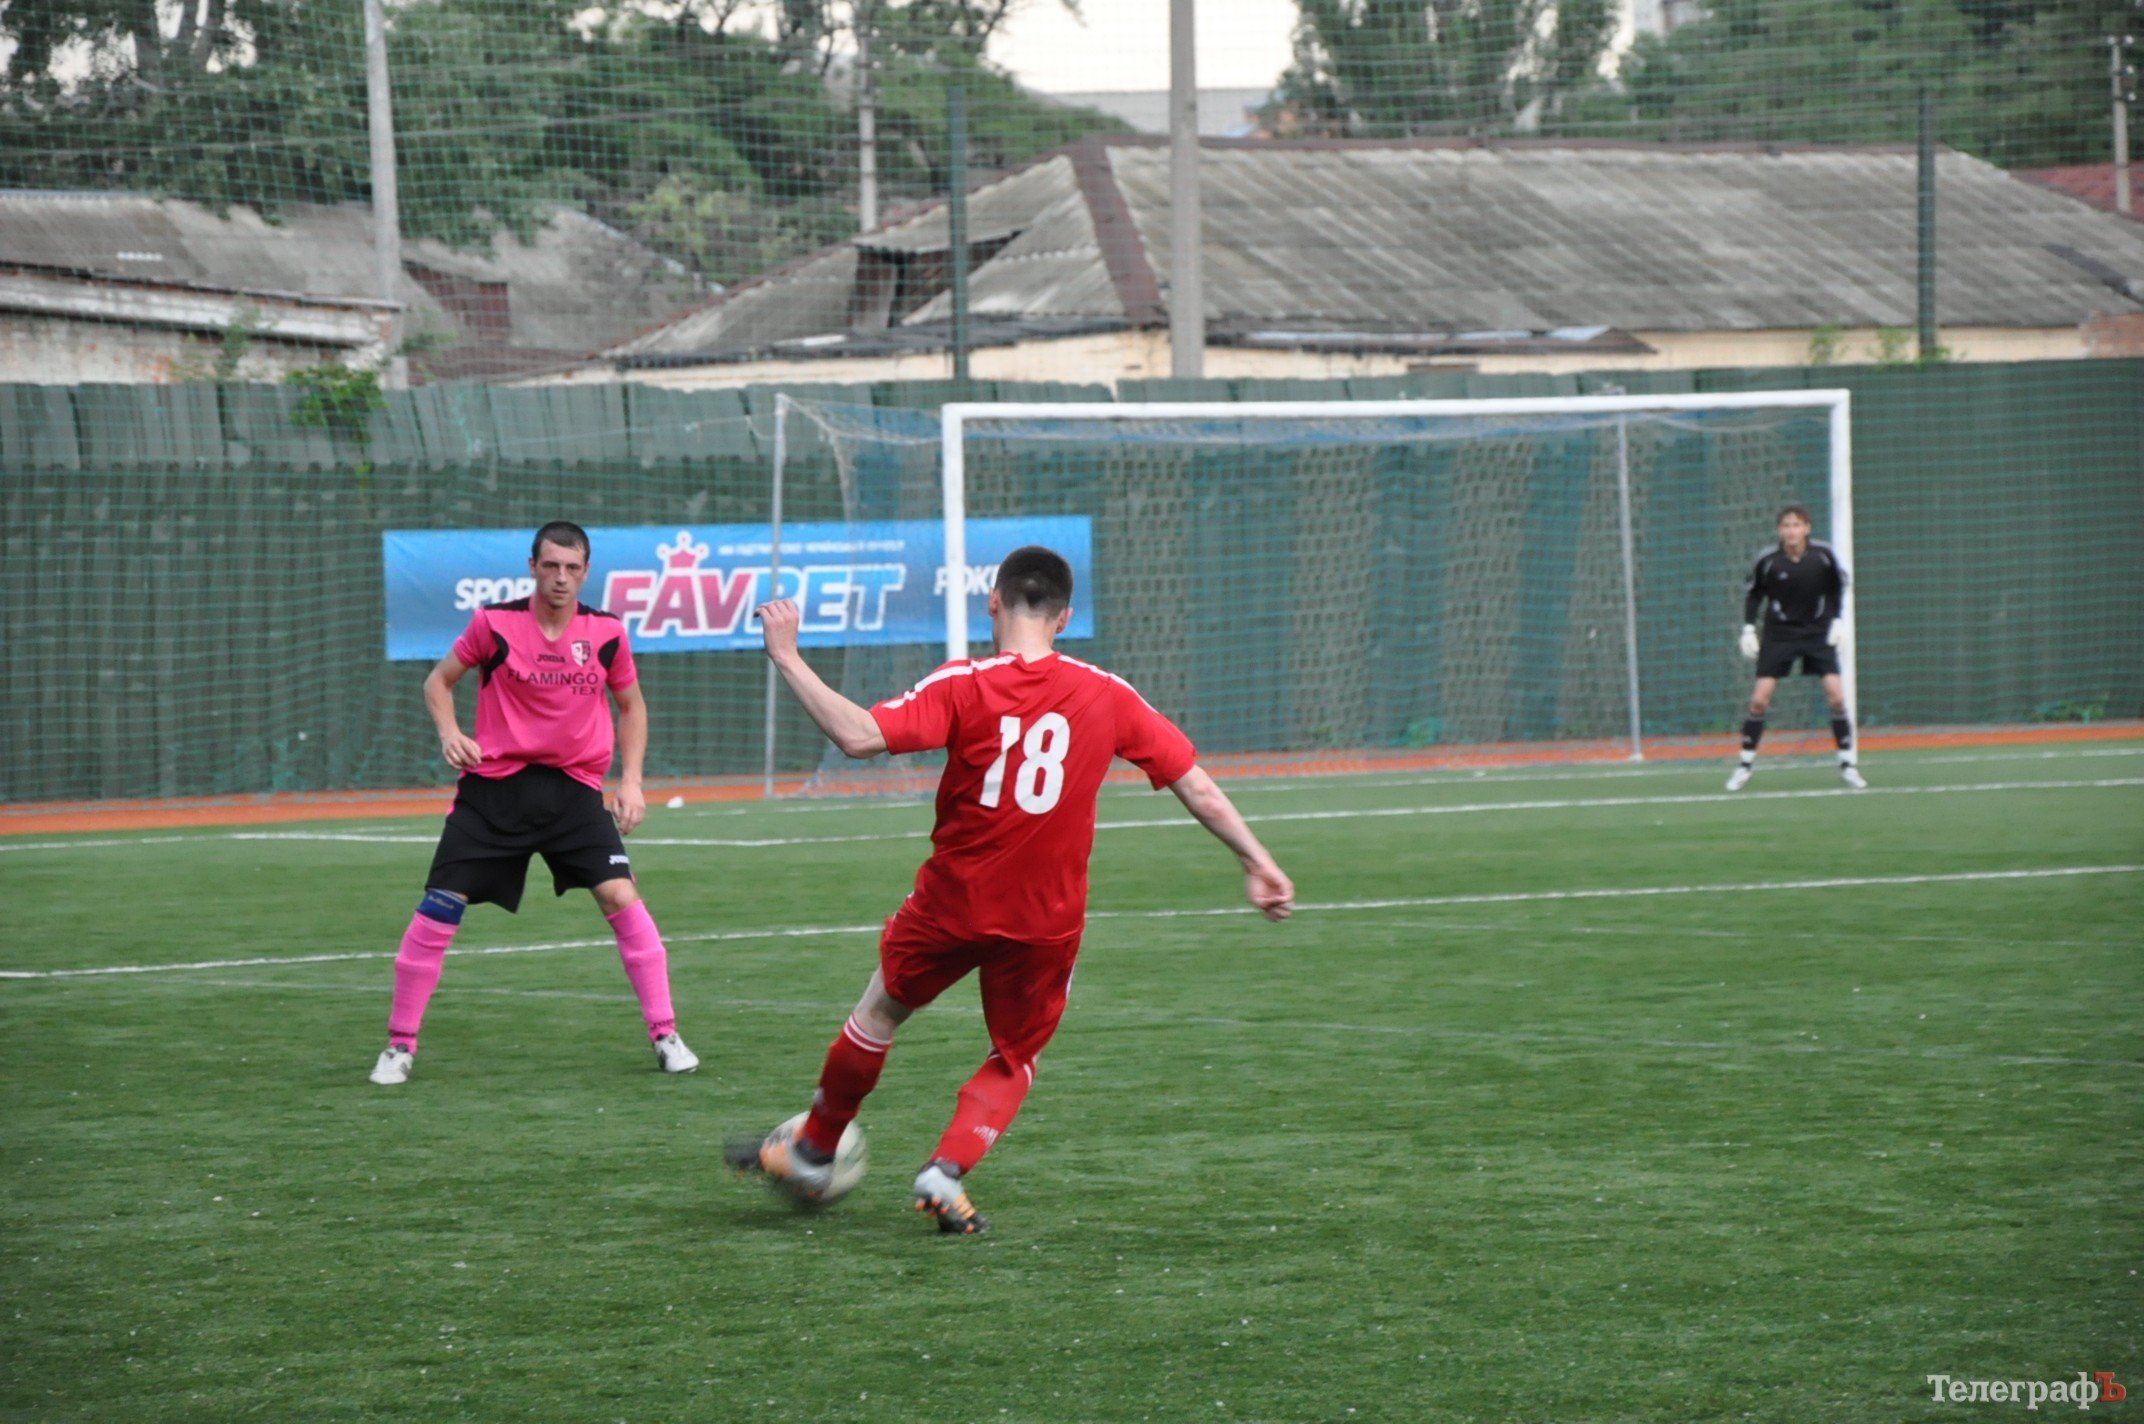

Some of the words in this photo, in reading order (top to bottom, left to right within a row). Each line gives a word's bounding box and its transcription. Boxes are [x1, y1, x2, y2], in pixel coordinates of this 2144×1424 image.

[507, 668, 599, 685] FLAMINGO
[571, 686, 597, 696] TEX
[979, 711, 1070, 815] 18
